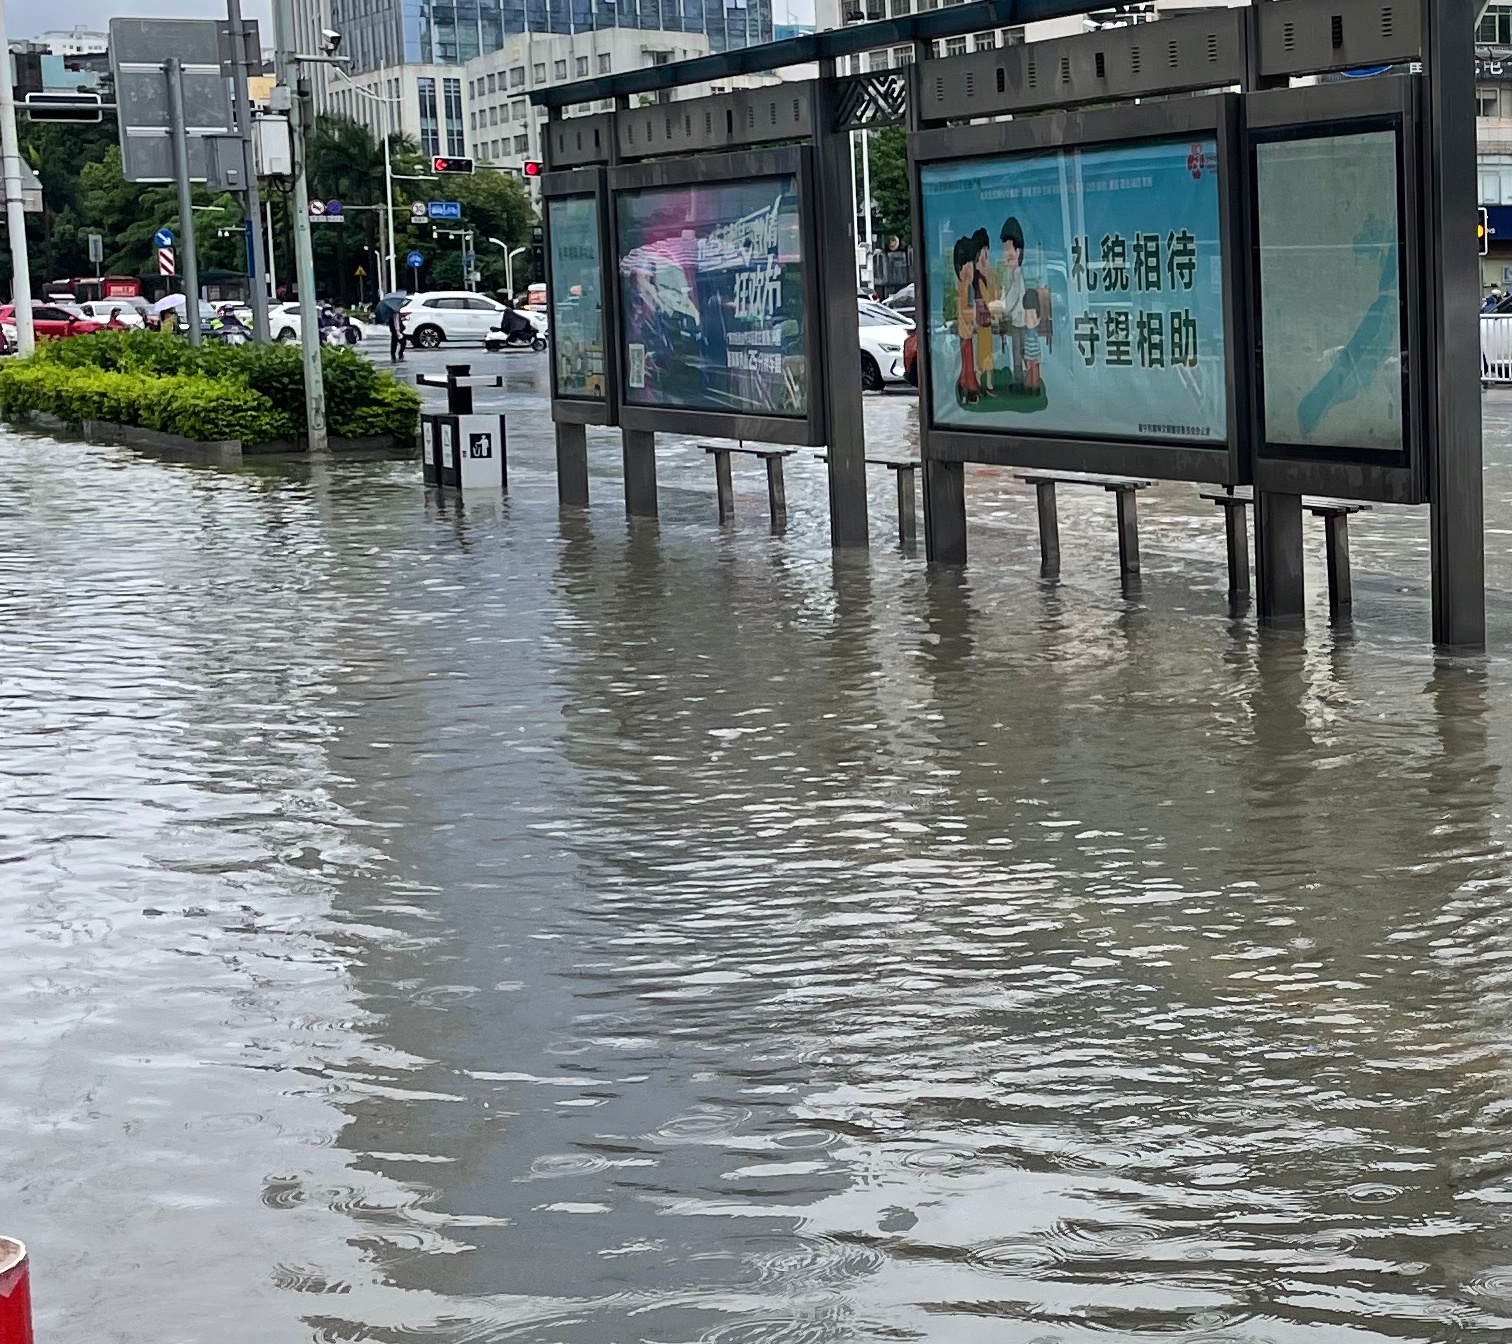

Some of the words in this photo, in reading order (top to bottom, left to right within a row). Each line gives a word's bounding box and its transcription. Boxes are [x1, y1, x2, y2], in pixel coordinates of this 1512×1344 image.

[1071, 229, 1196, 293] 礼貌相待
[1073, 308, 1198, 369] 守望相助
